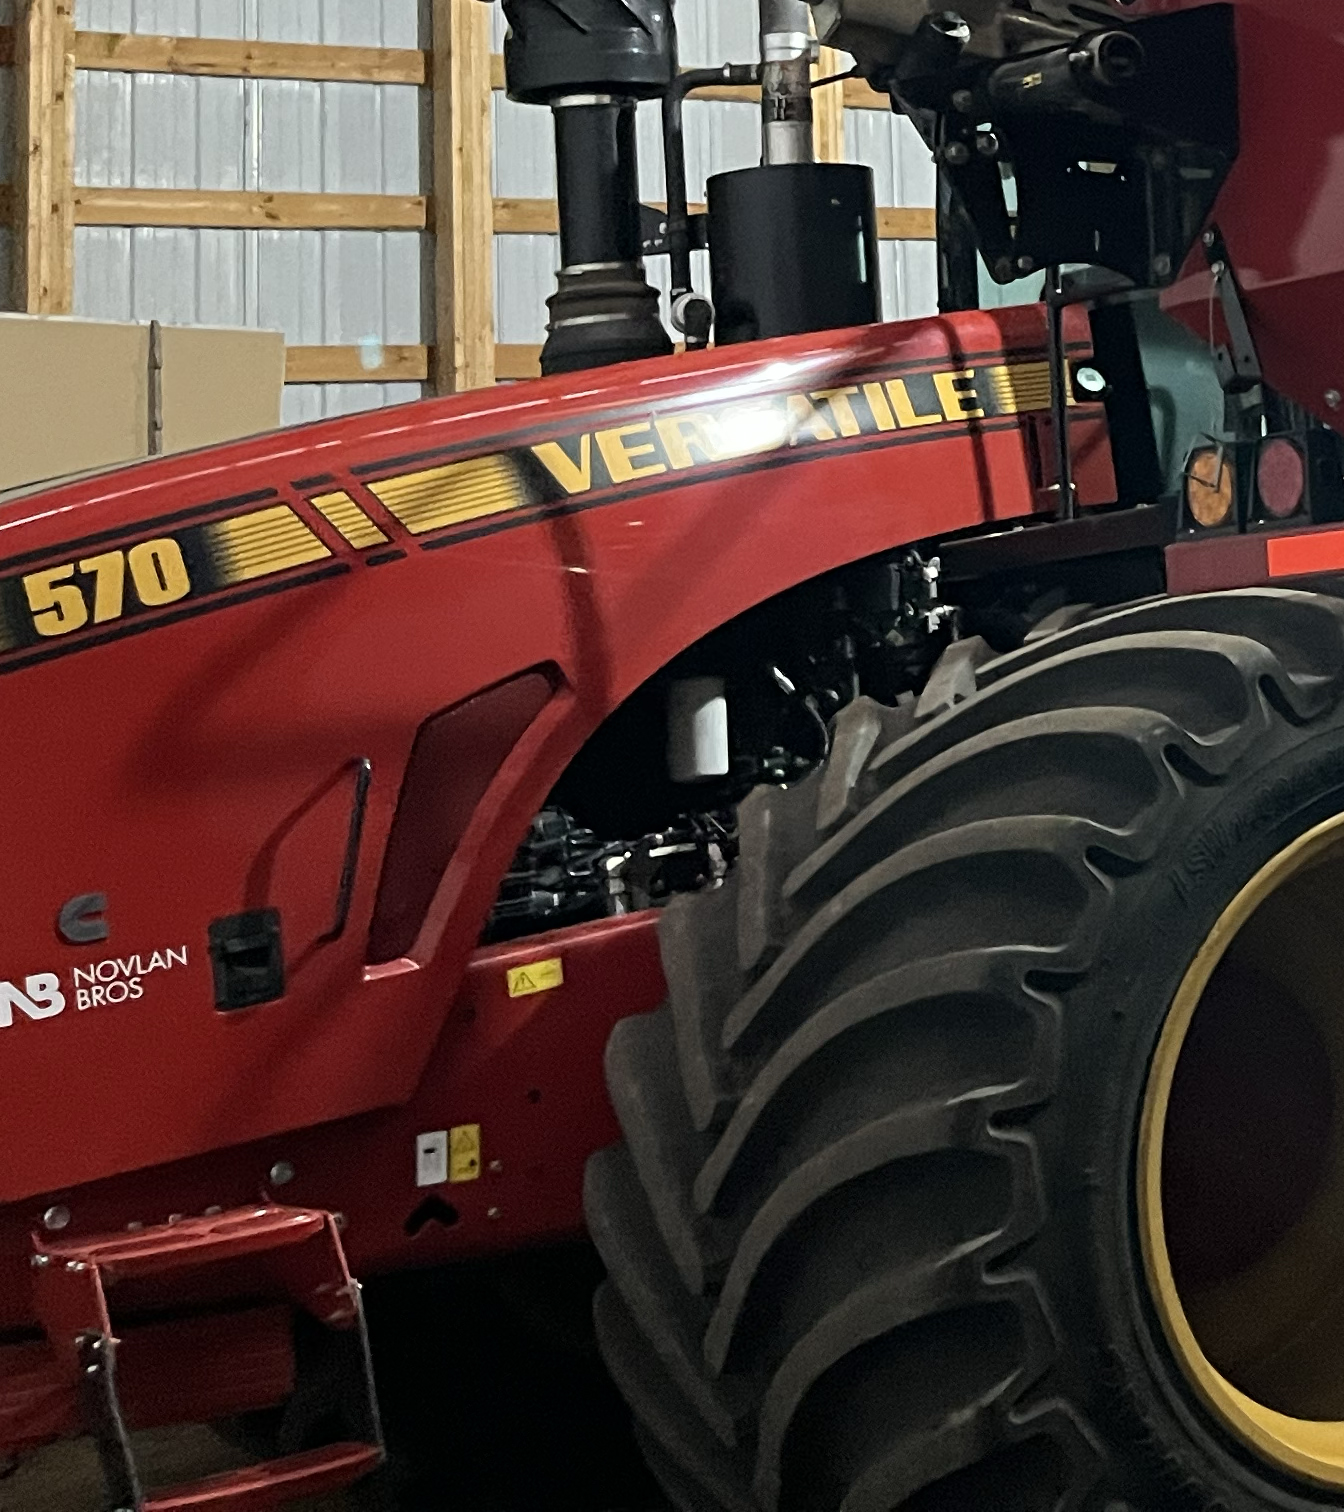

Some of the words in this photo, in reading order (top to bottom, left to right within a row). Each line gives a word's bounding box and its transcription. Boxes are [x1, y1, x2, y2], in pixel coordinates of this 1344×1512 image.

[531, 368, 985, 494] VERATILE
[23, 537, 191, 637] 570
[73, 945, 188, 988] NOVLAN
[76, 977, 144, 1011] BROS
